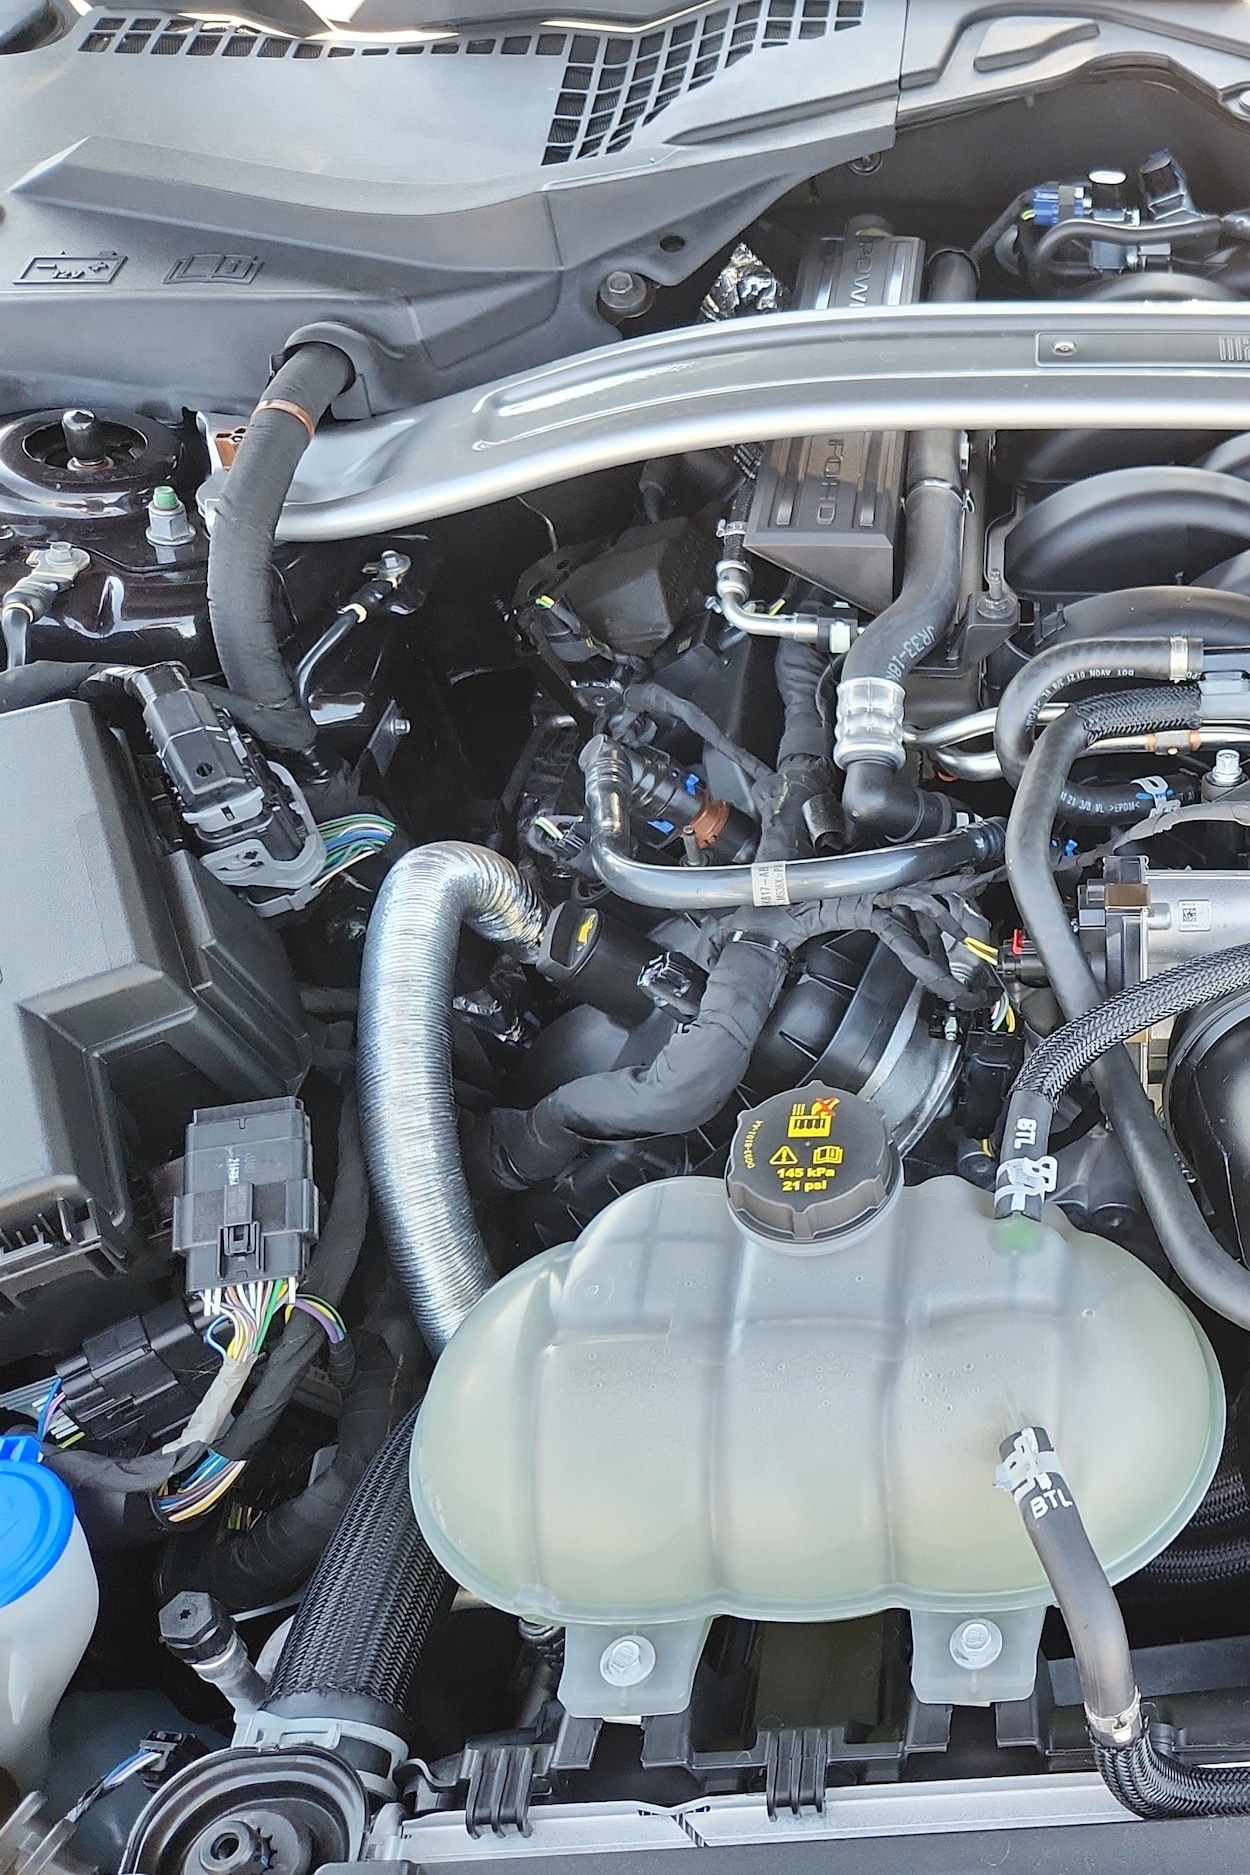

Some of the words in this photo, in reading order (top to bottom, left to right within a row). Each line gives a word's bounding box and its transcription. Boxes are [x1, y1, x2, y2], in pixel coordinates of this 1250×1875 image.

[53, 268, 85, 279] 12V
[816, 438, 845, 526] FORD
[1089, 669, 1111, 678] AVON
[1117, 669, 1134, 677] DOT
[1052, 677, 1065, 690] 3/8
[1078, 800, 1092, 812] 3/8
[1095, 804, 1105, 814] VL
[1109, 801, 1141, 813] >EPDM<
[776, 1167, 805, 1179] 145
[806, 1167, 836, 1178] kPa
[781, 1180, 801, 1192] 21
[803, 1179, 828, 1193] psi
[1029, 1488, 1074, 1520] BTL
